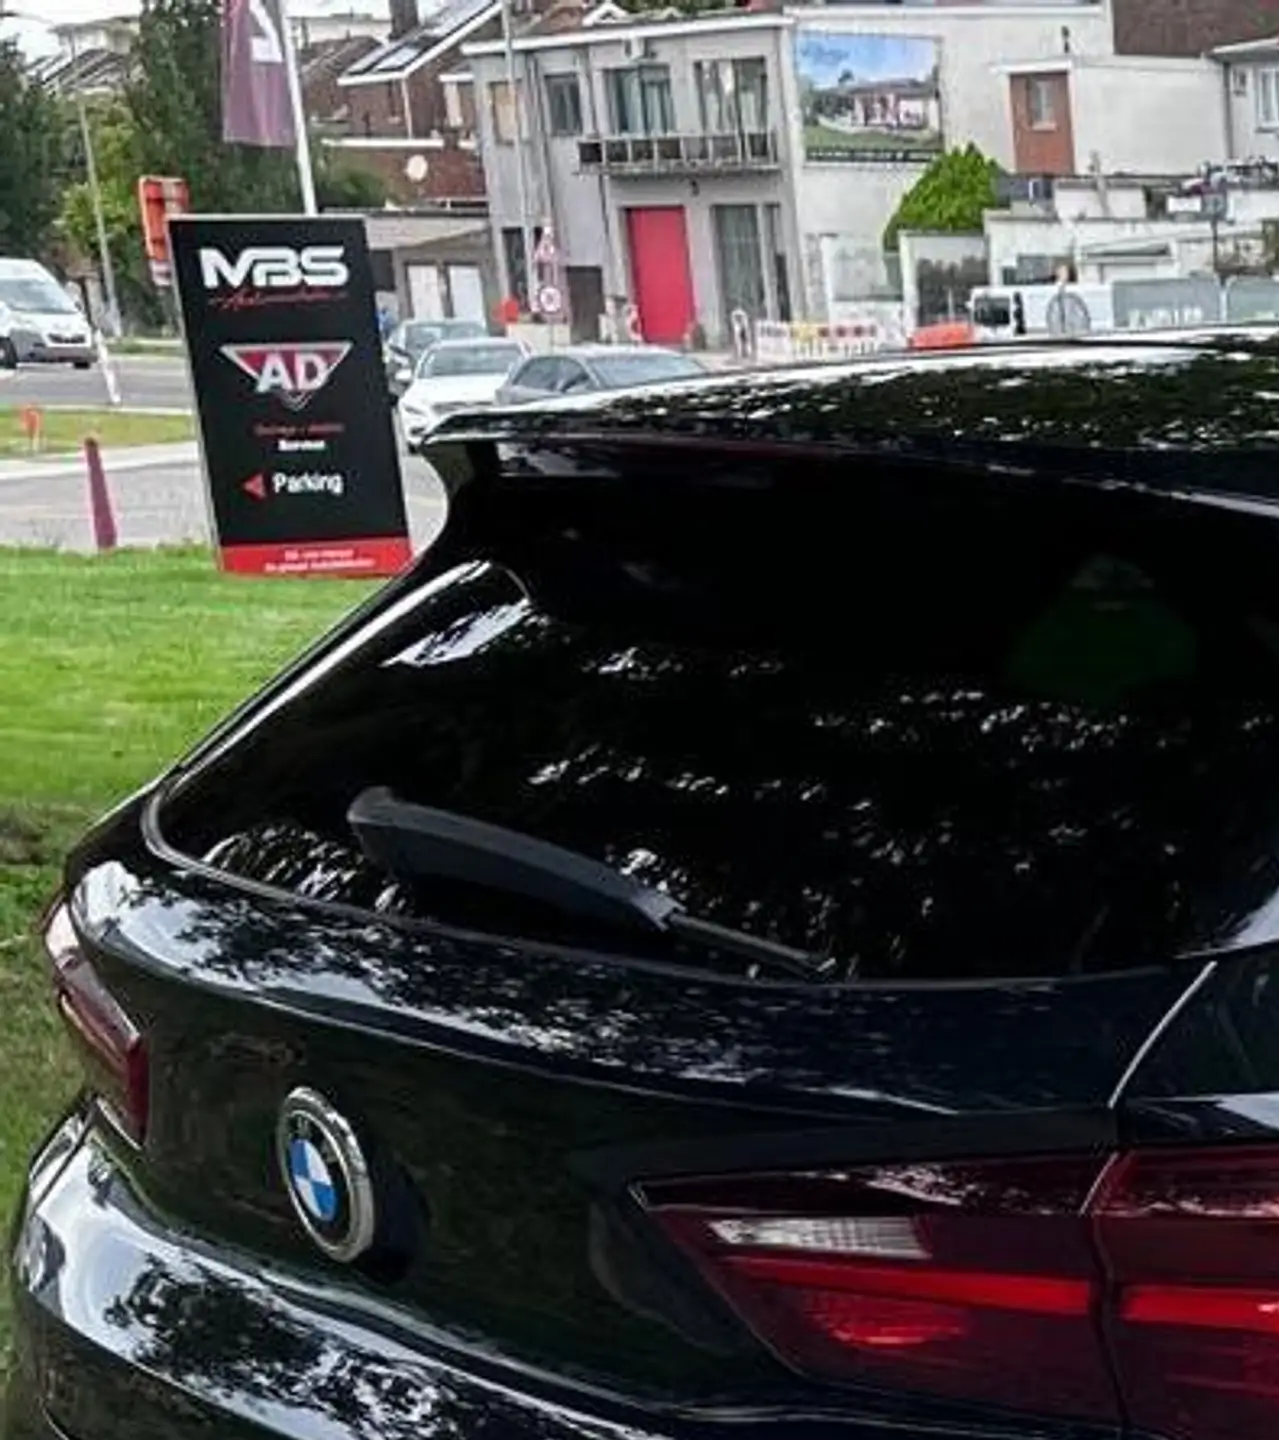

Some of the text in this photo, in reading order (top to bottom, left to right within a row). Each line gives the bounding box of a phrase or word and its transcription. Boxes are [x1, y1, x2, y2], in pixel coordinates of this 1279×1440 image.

[198, 245, 348, 289] MBS
[255, 352, 329, 393] AD
[272, 471, 344, 495] Parking
